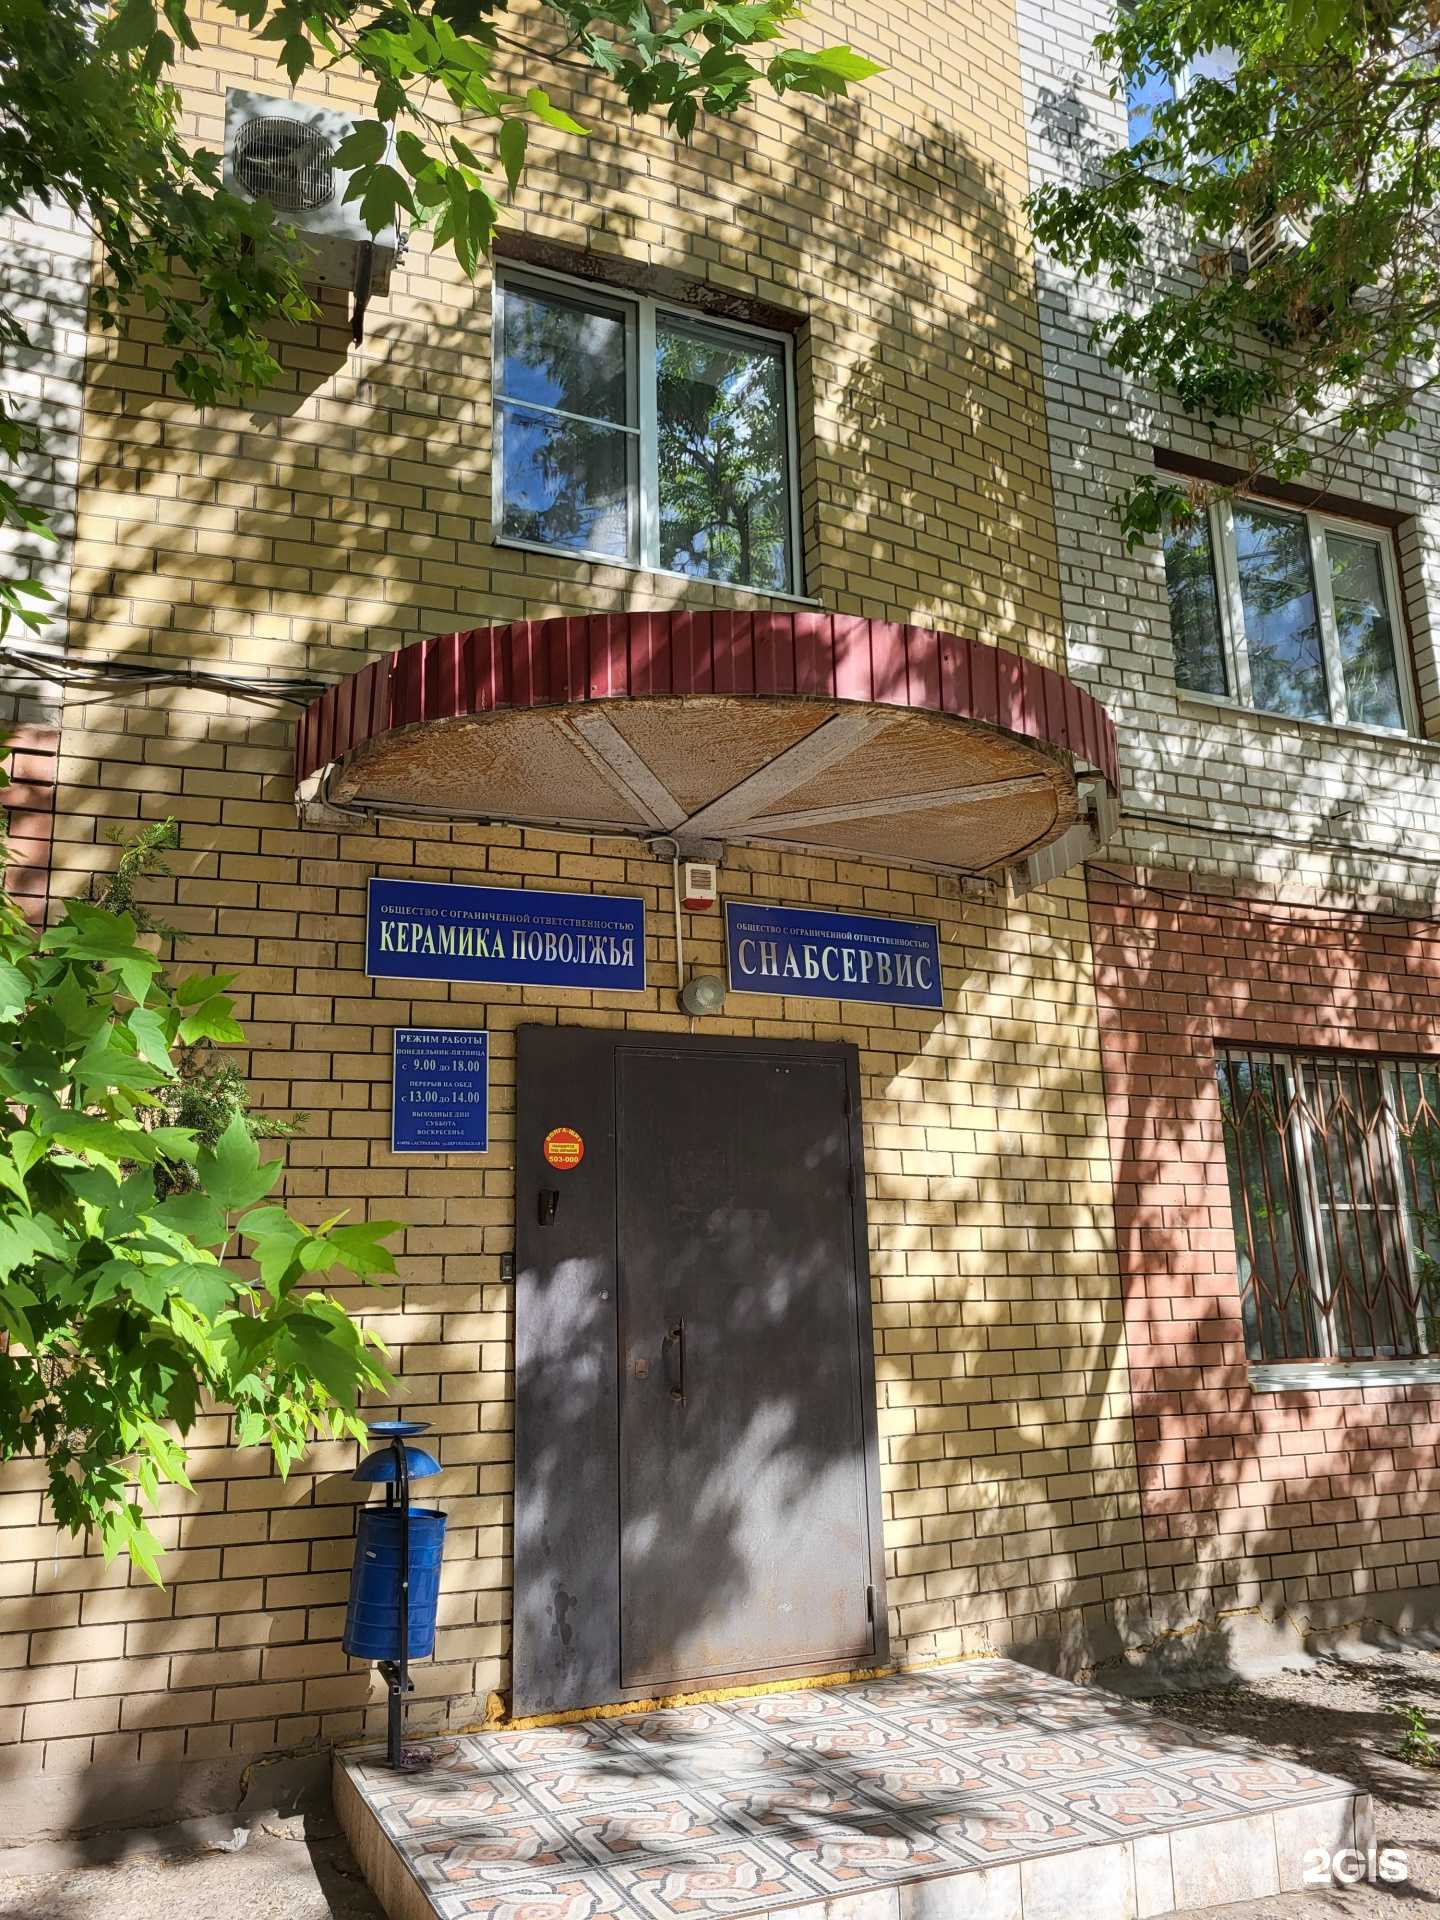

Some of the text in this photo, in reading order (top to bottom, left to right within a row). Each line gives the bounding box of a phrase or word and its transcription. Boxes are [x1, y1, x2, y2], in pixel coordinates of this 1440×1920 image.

[380, 904, 634, 931] ОБЩЕСТВО С ОГРАНИЧЕННОЙ ОТВЕТСТВЕННОСТЬЮ
[379, 920, 635, 967] КЕРАМИКА ПОВОЛЖЬЯ
[736, 922, 782, 934] ОБЩЕСТВО
[789, 927, 852, 941] ОГРАНИЧЕННОЙ
[853, 933, 930, 949] ОТВЕТСТВЕННОСТЬЮ
[738, 938, 933, 990] СНАБСЕРВИС
[400, 1034, 482, 1045] РЕЖИМ РАБОТЫ
[413, 1058, 436, 1071] 9.00
[452, 1060, 480, 1072] 18.00
[409, 1091, 438, 1103] 13.00
[452, 1092, 480, 1104] 14.00
[425, 1120, 456, 1128] СУББОТА
